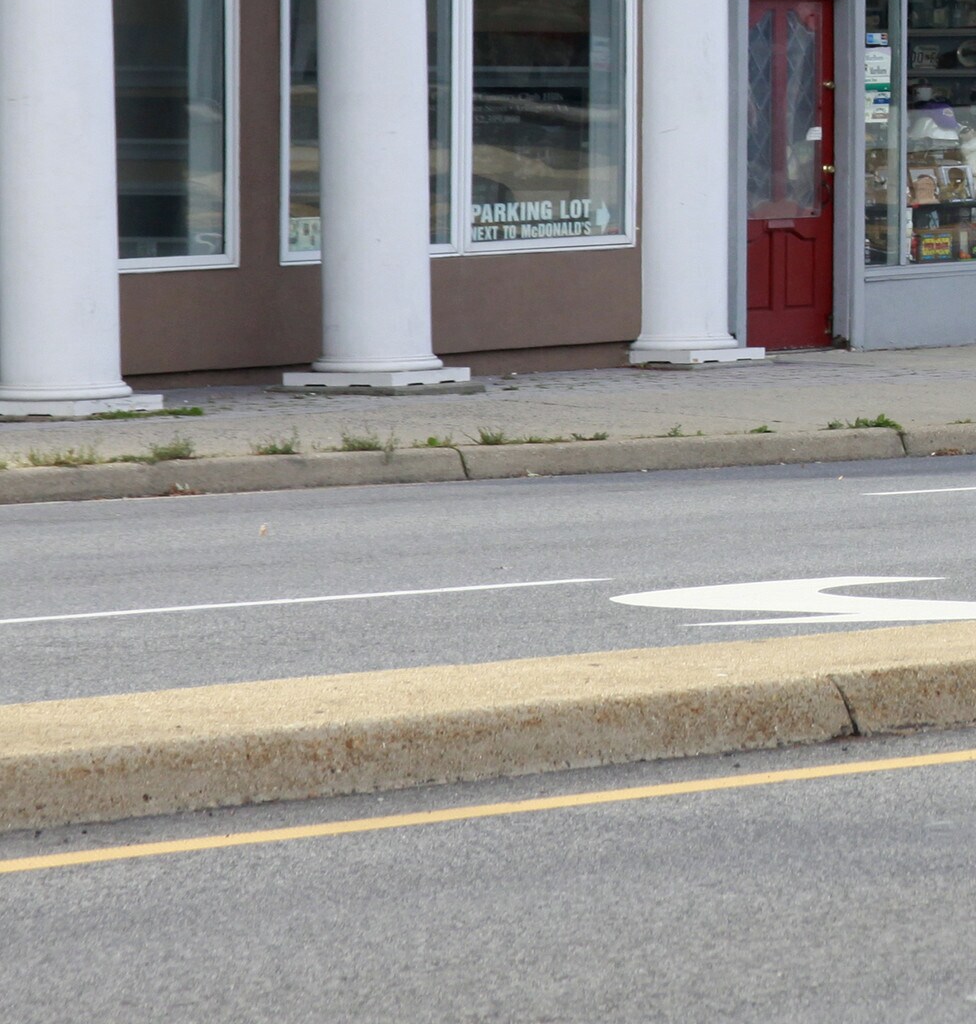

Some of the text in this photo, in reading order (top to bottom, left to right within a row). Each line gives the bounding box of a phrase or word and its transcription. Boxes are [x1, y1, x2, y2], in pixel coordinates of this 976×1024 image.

[472, 199, 592, 223] PARKING LOT
[472, 221, 592, 241] NEXT TO McDONALD'S
